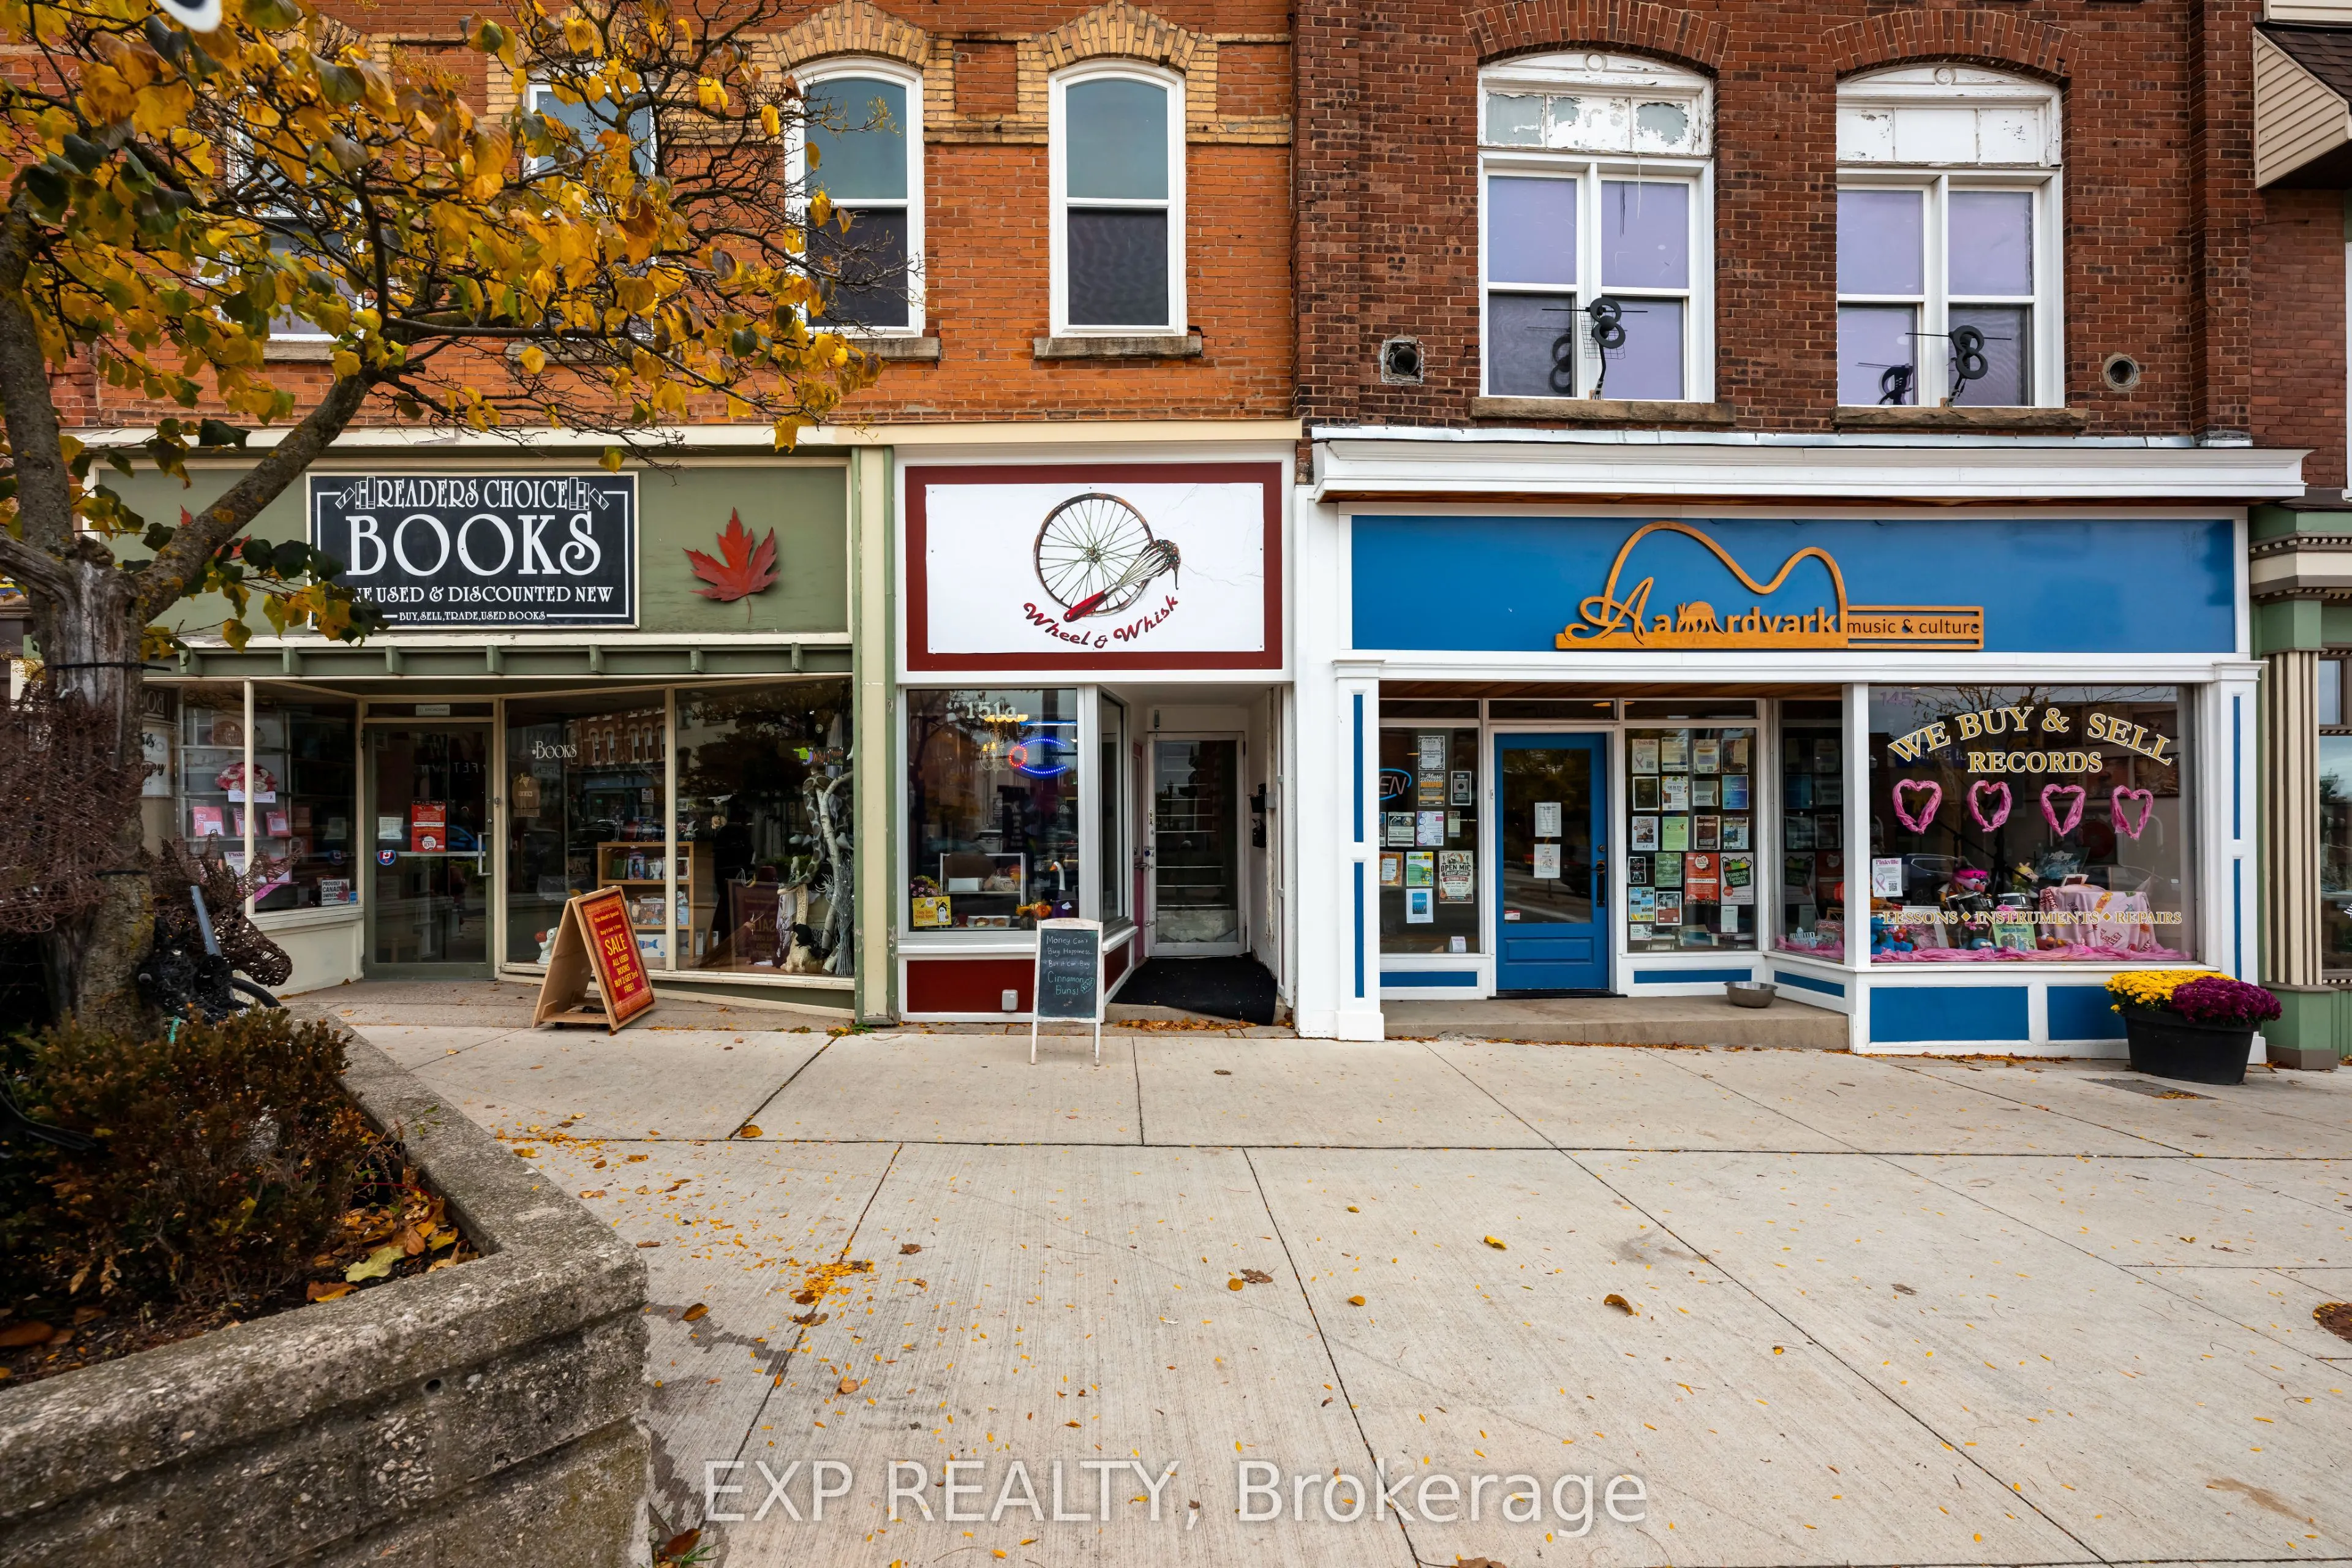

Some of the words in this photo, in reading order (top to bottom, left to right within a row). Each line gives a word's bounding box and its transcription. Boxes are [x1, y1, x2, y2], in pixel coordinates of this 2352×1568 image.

[377, 479, 479, 509] READERS
[484, 479, 568, 509] CHOICE
[345, 511, 601, 576] BOOKS
[376, 586, 424, 603] USED
[429, 586, 444, 603] &
[448, 586, 571, 603] DISCOUNTED
[576, 586, 614, 603] NEW
[508, 611, 546, 620] BOOKS
[1023, 602, 1091, 646] Wheel
[1094, 635, 1108, 648] &
[1114, 595, 1178, 642] Whisk
[1847, 619, 1896, 633] music
[1901, 619, 1913, 633] &
[1919, 619, 1980, 633] culture
[964, 701, 1018, 719] 151a
[1888, 721, 1951, 763] WE
[1955, 706, 2034, 741] BUY
[2041, 707, 2070, 734] &
[2087, 713, 2173, 766] SELL
[1967, 752, 2103, 773] RECORDS
[1883, 911, 1958, 925] LESSONS
[1975, 911, 2099, 925] INSTRUMENTS
[2115, 911, 2182, 925] REPAIRS
[605, 933, 627, 956] SALE
[1046, 935, 1071, 945] Money
[1047, 947, 1060, 957] Buy
[612, 957, 621, 967] ALL
[619, 954, 630, 965] USED
[1049, 959, 1058, 968] But
[1079, 960, 1090, 970] Buy
[617, 963, 630, 976] BOOKS
[614, 978, 623, 988] BUY
[621, 976, 625, 985] 2
[1047, 971, 1084, 983] Cinnamon
[624, 982, 635, 994] FREE!
[1055, 984, 1079, 995] Buns!
